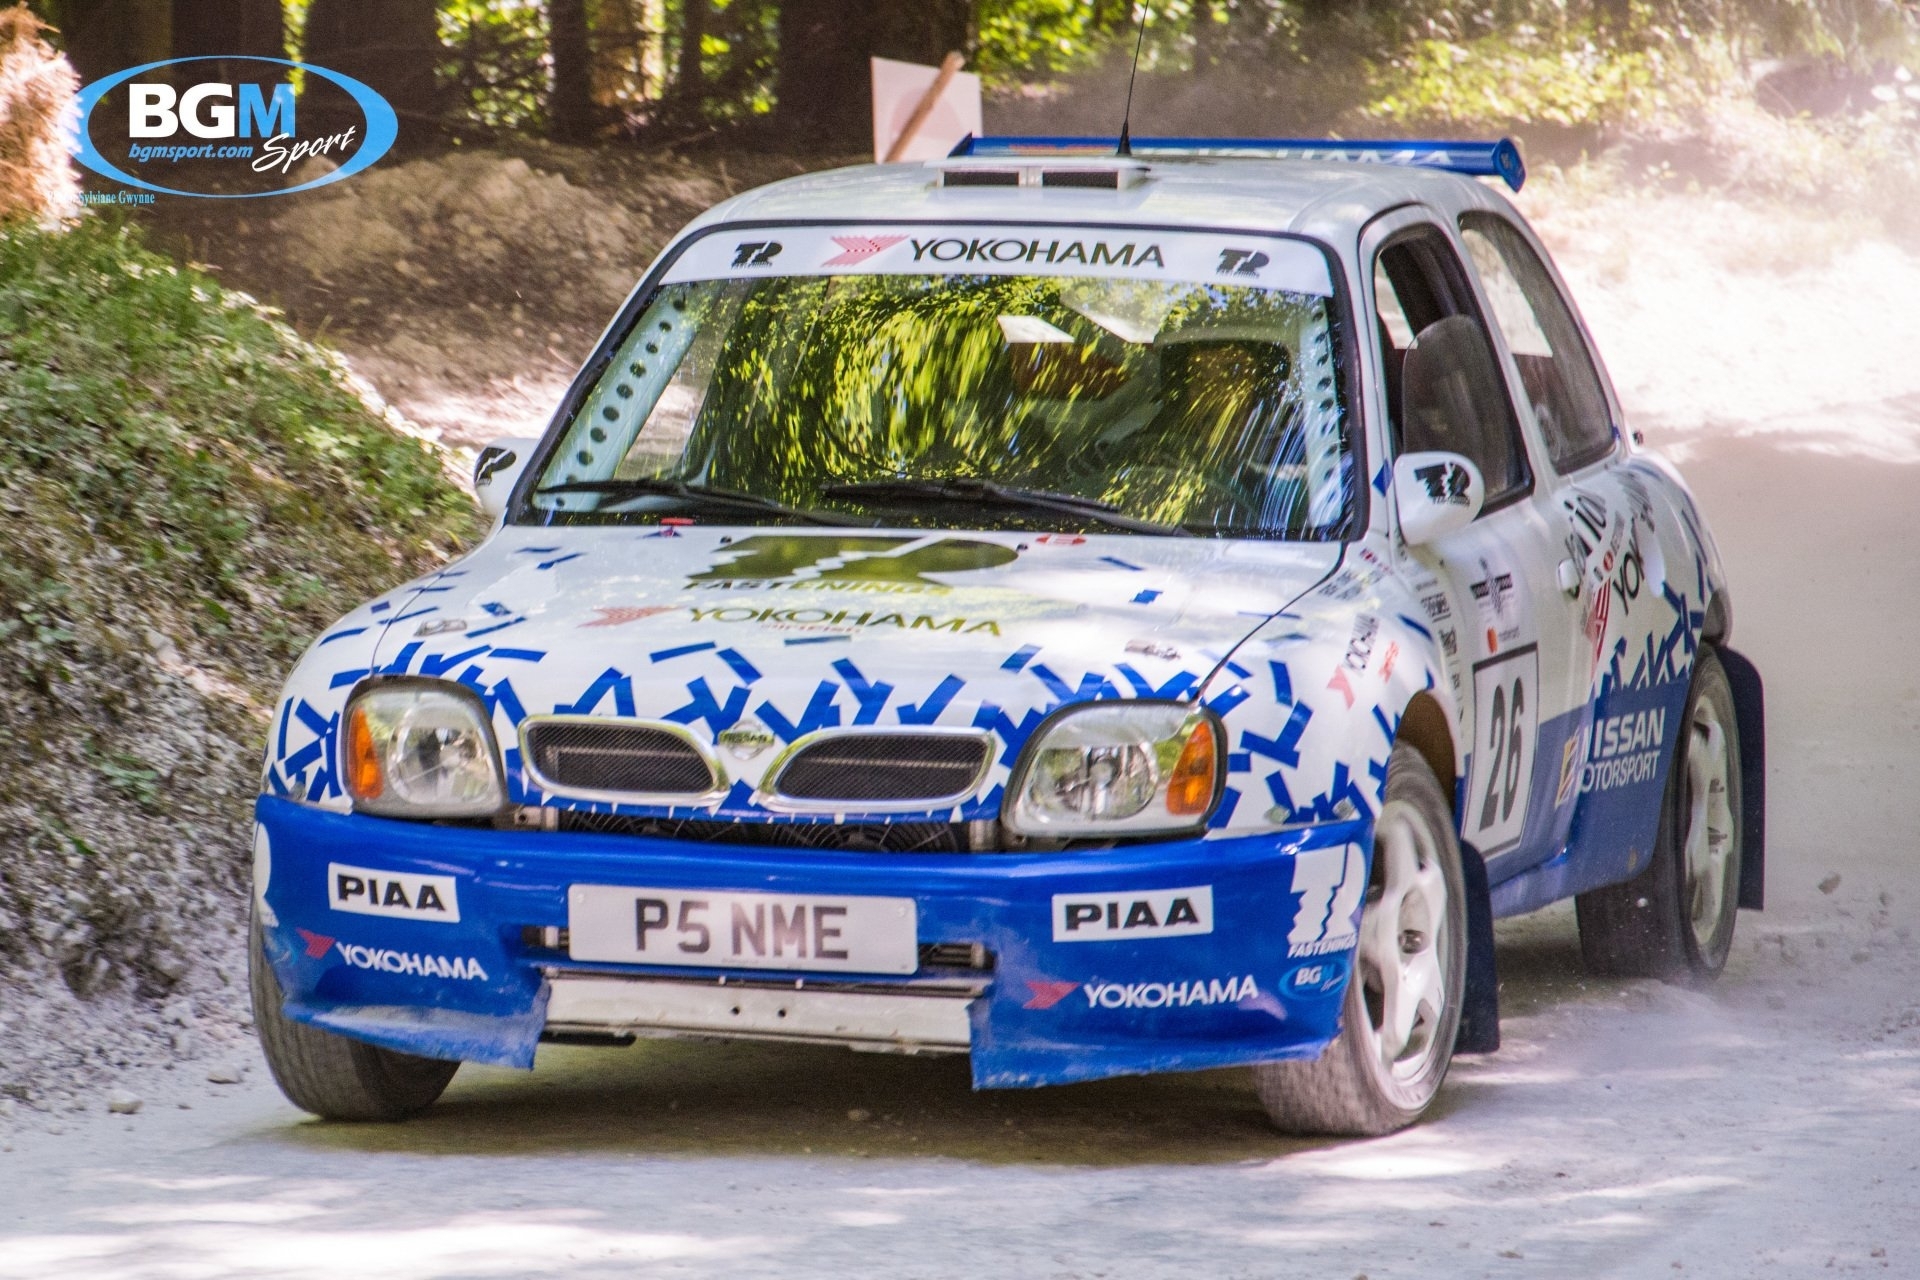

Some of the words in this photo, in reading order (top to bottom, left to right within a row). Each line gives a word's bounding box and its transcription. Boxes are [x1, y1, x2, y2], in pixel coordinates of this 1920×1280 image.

[911, 238, 1165, 268] YOKOHAMA
[689, 607, 1002, 637] YOKOHAMA
[1478, 677, 1525, 833] 26
[336, 873, 447, 912] PIAA
[635, 898, 711, 954] P5
[731, 902, 849, 961] NME
[1065, 897, 1199, 931] PIAA
[335, 940, 489, 981] YOKOHAMA
[1083, 973, 1260, 1008] YOKOHAMA
